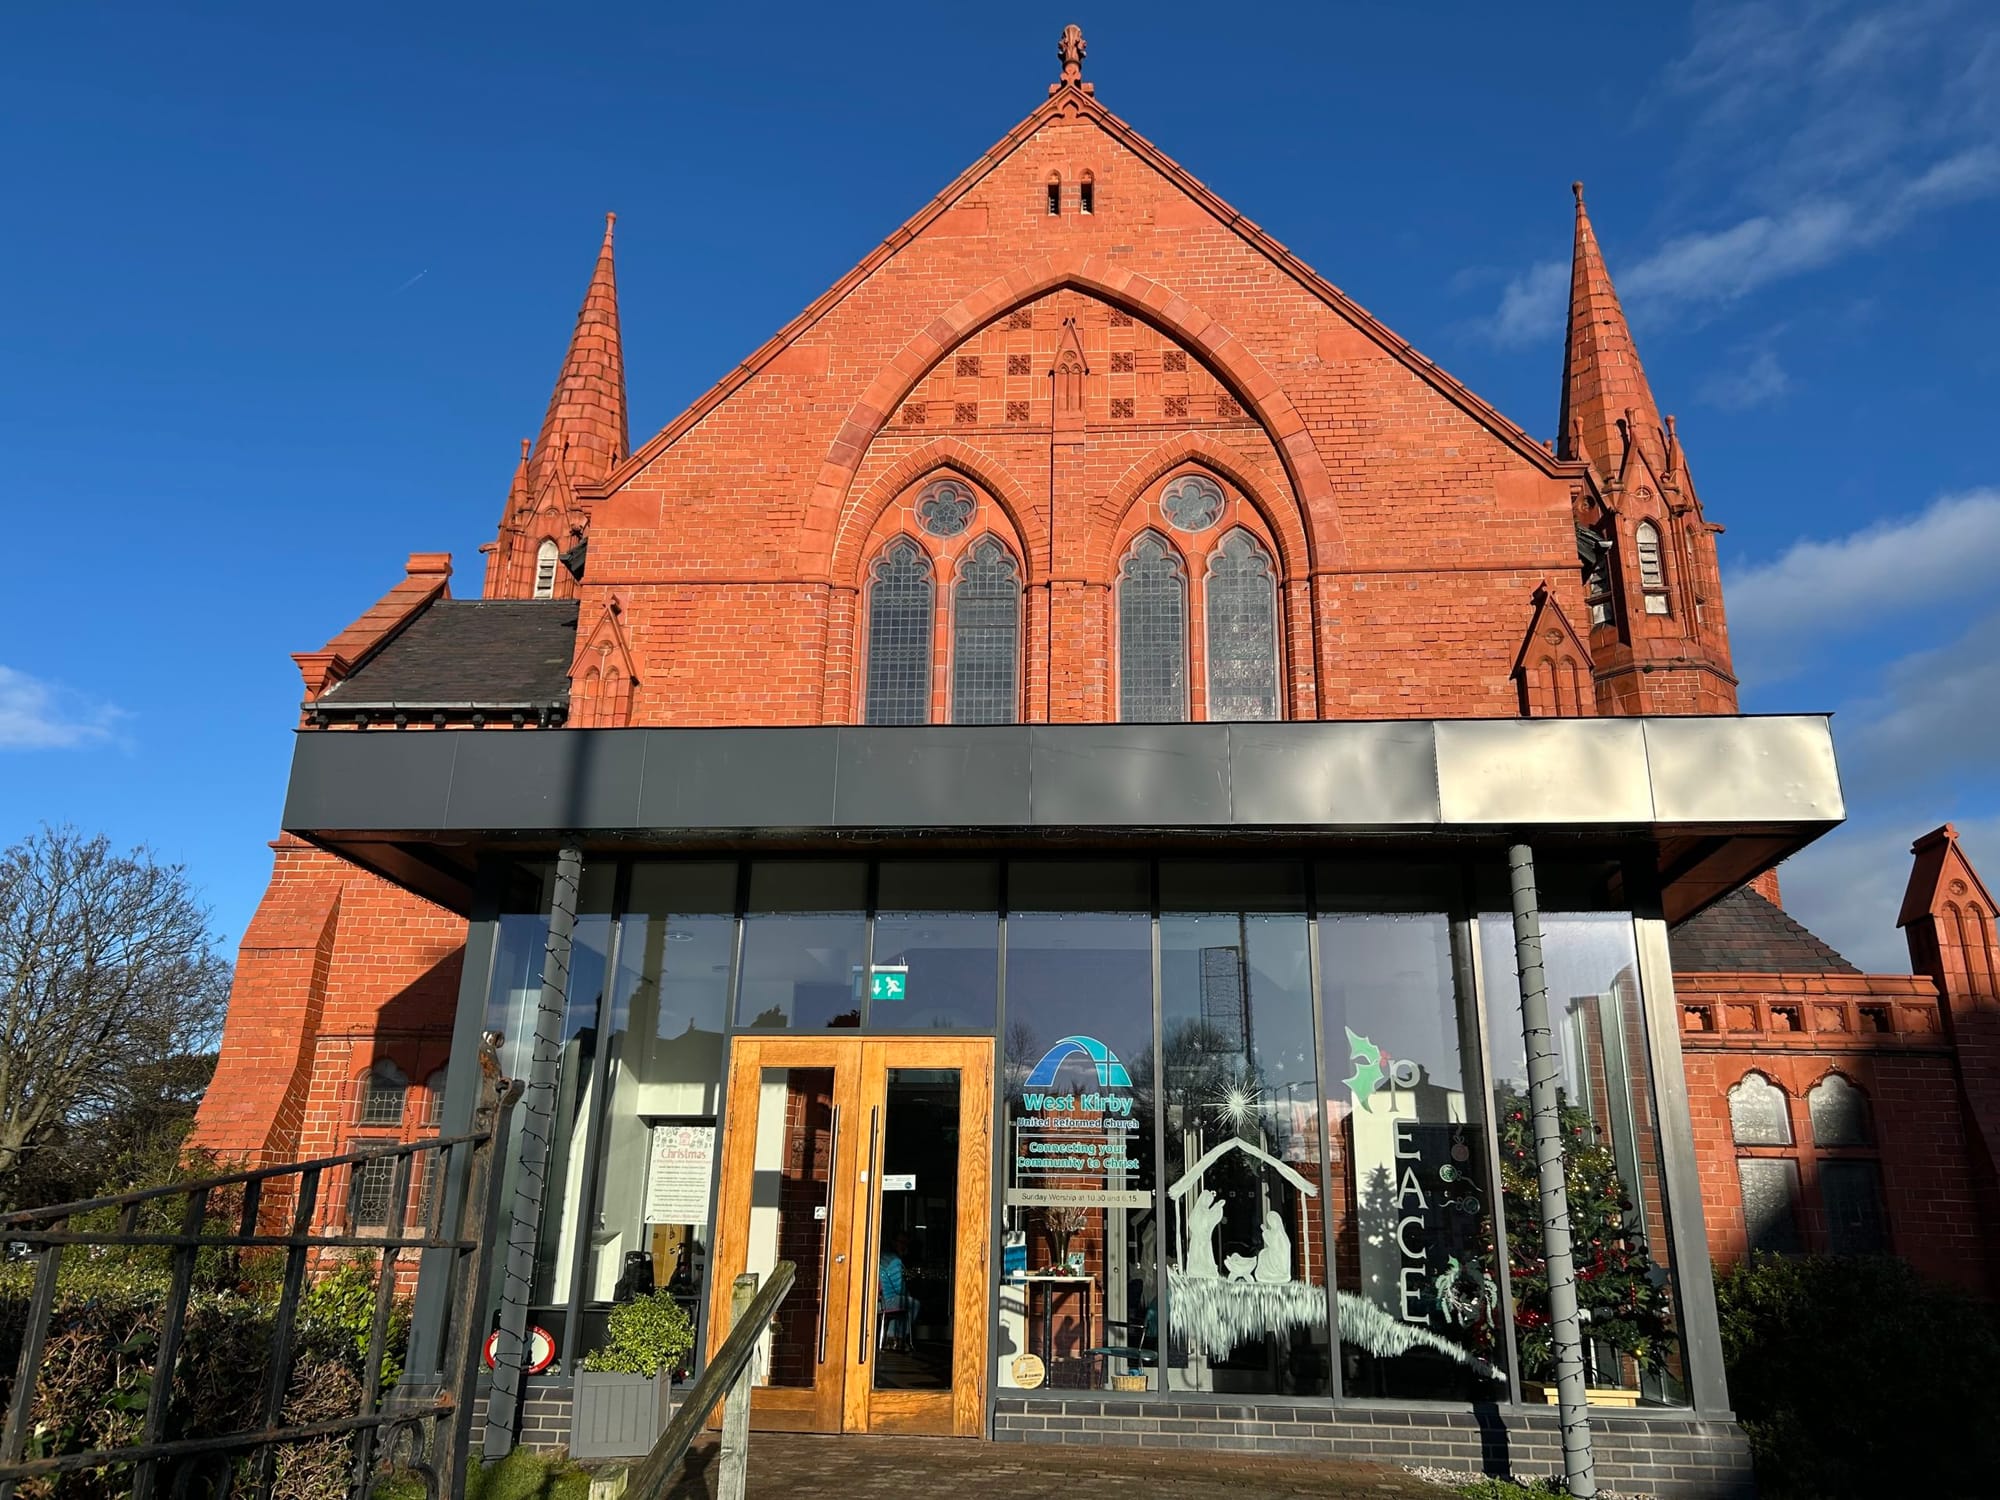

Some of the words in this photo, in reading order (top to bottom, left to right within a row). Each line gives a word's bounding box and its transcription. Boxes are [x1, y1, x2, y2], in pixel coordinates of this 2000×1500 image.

[1023, 1093, 1075, 1111] West
[1081, 1093, 1133, 1116] Kirby
[1016, 1117, 1050, 1128] United
[1053, 1117, 1101, 1128] Reformed
[1104, 1118, 1139, 1129] Church
[661, 1148, 707, 1159] Christmas
[1029, 1142, 1096, 1155] Connecting
[1098, 1144, 1126, 1157] your
[1018, 1156, 1085, 1170] Community
[1087, 1157, 1100, 1168] to
[1103, 1157, 1140, 1169] Christ
[1021, 1192, 1047, 1202] Sunday
[1048, 1192, 1077, 1202] Worship
